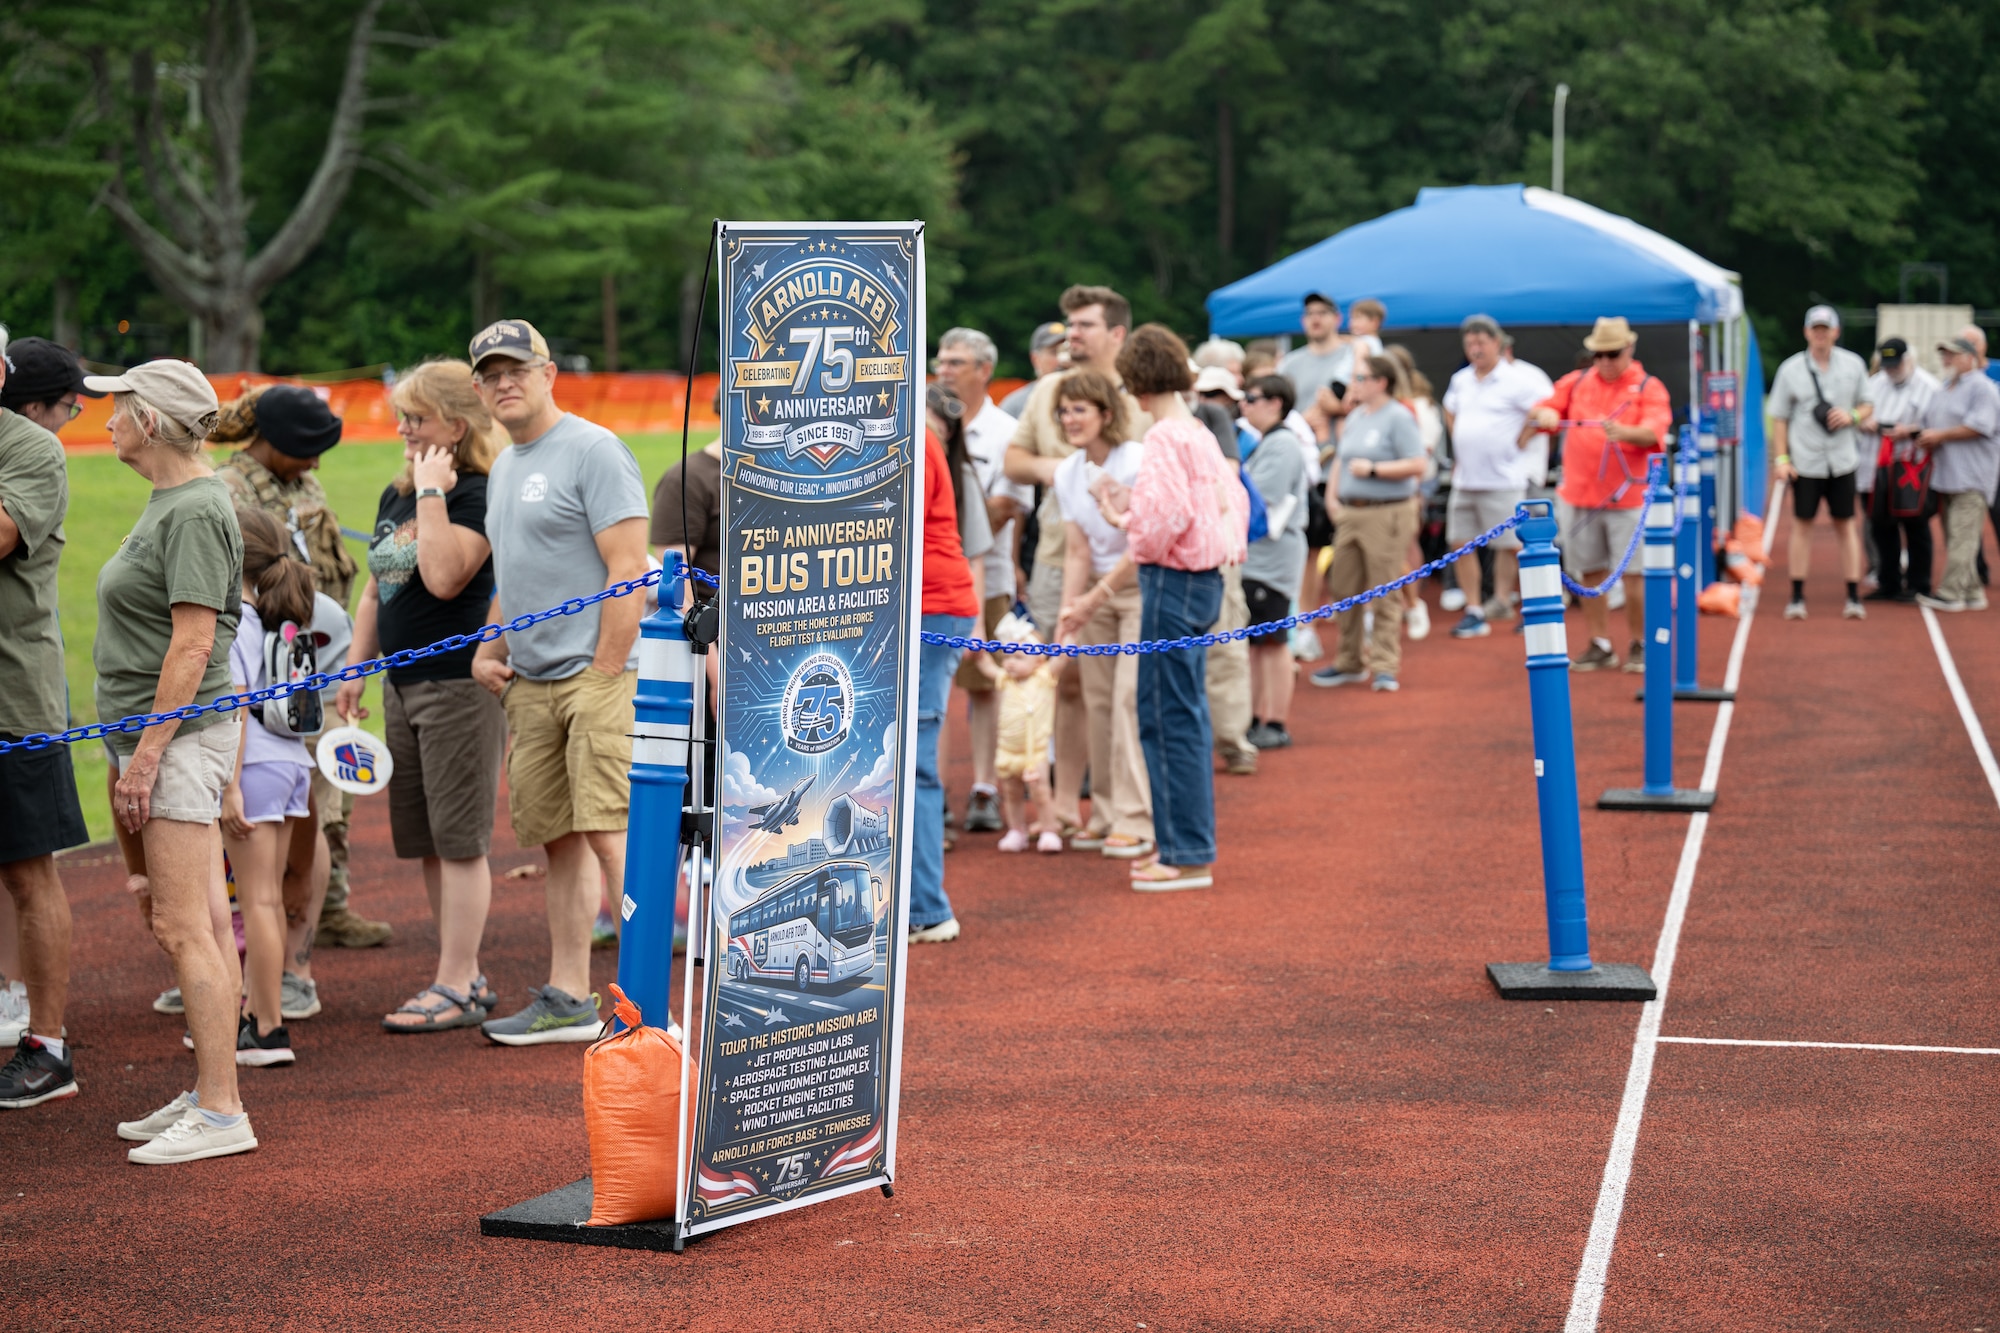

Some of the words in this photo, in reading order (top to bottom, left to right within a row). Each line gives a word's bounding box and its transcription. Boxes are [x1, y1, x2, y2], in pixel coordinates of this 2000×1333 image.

[761, 271, 842, 327] ARNOLD
[846, 278, 886, 322] AFB
[743, 367, 790, 381] CELEBRATING
[789, 326, 870, 394] 75th
[860, 362, 900, 376] EXCELLENCE
[774, 395, 873, 419] ANNIVERSARY
[768, 429, 782, 438] 2026
[796, 426, 828, 445] SINCE
[831, 426, 853, 442] 1951
[739, 469, 778, 491] HONORING
[780, 481, 794, 494] OUR
[795, 483, 820, 496] LEGACY
[825, 476, 863, 495] INNOVATING
[863, 472, 877, 485] OUR
[877, 458, 899, 482] FUTURE
[740, 526, 779, 551] 75th
[783, 517, 895, 548] ANNIVERSARY
[740, 552, 809, 595] BUS
[817, 543, 894, 588] TOUR
[743, 598, 796, 619] MISSION
[797, 595, 826, 615] AREA
[828, 596, 836, 611] &
[838, 588, 889, 609] FACILITIES
[756, 620, 792, 635] EXPLORE
[793, 619, 807, 632] THE
[809, 617, 829, 630] HOME
[830, 616, 839, 627] OF
[840, 614, 851, 625] AIR
[852, 611, 874, 624] FORCE
[769, 633, 796, 648] FLIGHT
[797, 631, 815, 644] TEST
[816, 630, 822, 642] &
[822, 626, 863, 641] EVALUATION
[787, 656, 818, 696] ENGINEERING
[818, 654, 850, 683] DEVELOPMENT
[846, 683, 854, 721] COMPLEX
[795, 684, 842, 742] 75
[794, 741, 810, 752] YEARS
[815, 736, 841, 751] INNOVATION
[862, 816, 877, 829] AEDC
[754, 933, 766, 955] 75
[785, 927, 795, 939] AFB
[795, 923, 808, 937] TOUR
[720, 1038, 747, 1057] TOUR
[750, 1034, 769, 1051] THE
[770, 1024, 814, 1047] HISTORIC
[816, 1014, 855, 1035] MISSION
[856, 1007, 878, 1027] AREA
[732, 1064, 787, 1088] AEROSPACE
[789, 1054, 826, 1074] TESTING
[827, 1044, 870, 1065] ALLIANCE
[754, 1053, 771, 1068] JET
[773, 1039, 828, 1064] PROPULSION
[830, 1033, 854, 1050] LABS
[729, 1086, 761, 1104] SPACE
[762, 1070, 829, 1097] ENVIRONMENT
[829, 1060, 871, 1081] COMPLEX
[743, 1096, 781, 1117] ROCKET
[782, 1088, 816, 1107] ENGINE
[817, 1079, 855, 1099] TESTING
[742, 1115, 768, 1132] WIND
[769, 1106, 806, 1126] TUNNEL
[806, 1094, 854, 1117] FACILITIES
[711, 1145, 749, 1164] ARNOLD
[749, 1141, 765, 1156] AIR
[766, 1134, 794, 1151] FORCE
[794, 1129, 818, 1145] BASE
[824, 1113, 872, 1136] TENNESSEE
[775, 1152, 812, 1185] 75th
[770, 1177, 809, 1194] ANNIVERSARY
